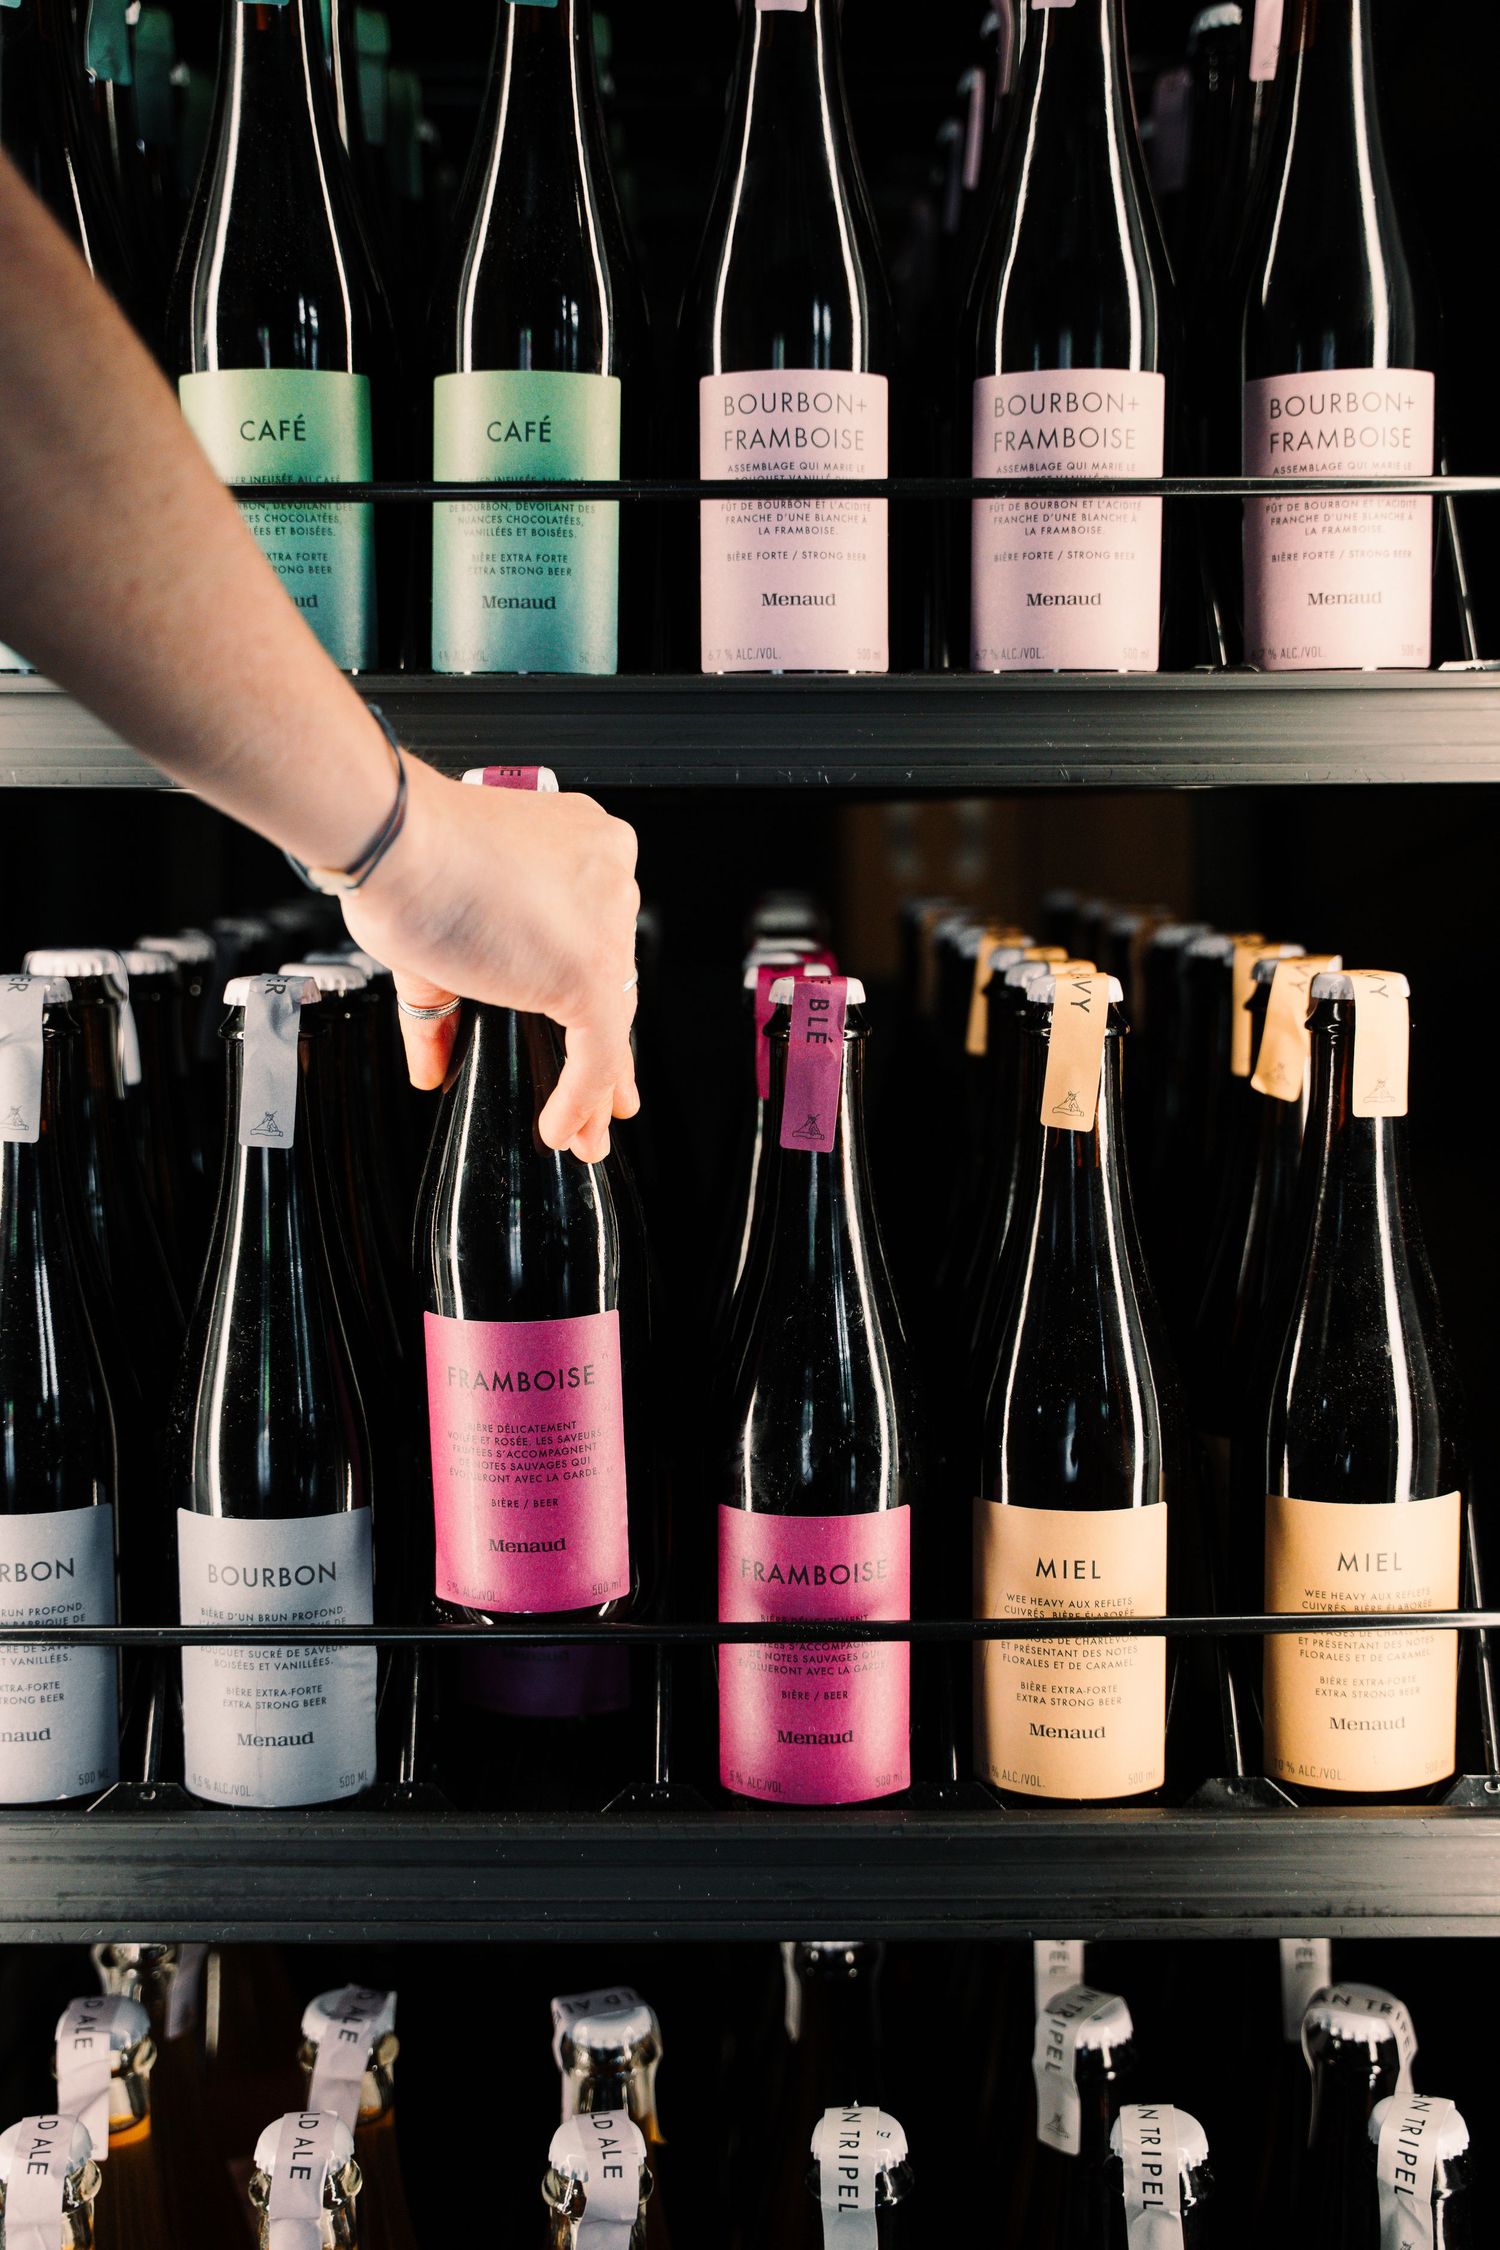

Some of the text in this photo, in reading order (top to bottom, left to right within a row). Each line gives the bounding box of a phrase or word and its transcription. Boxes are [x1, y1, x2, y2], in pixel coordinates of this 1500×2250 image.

[724, 392, 867, 416] BOURBON+
[994, 392, 1140, 418] BOURBON+
[1270, 392, 1414, 419] BOURBON+
[240, 414, 306, 441] CAFÉ
[487, 416, 551, 442] CAFÉ
[724, 428, 864, 450] FRAMBOISE
[994, 427, 1135, 452] FRAMBOISE
[1270, 427, 1411, 453] FRAMBOISE
[728, 462, 852, 473] ASSEMBLAGE QUI MARIE
[997, 462, 1136, 474] ASSEMBLAGE QUI MARIE LE
[1273, 462, 1412, 475] ASSEMBLAGE QUI MARIE LE
[741, 500, 826, 510] DE BOURBON ET
[1008, 500, 1093, 511] DE BOURBON ET
[1287, 500, 1358, 512] DE BOURBON
[264, 513, 342, 524] CHOCOLATÉES,
[458, 514, 584, 527] NUANCES CHOCOLATÉES,
[726, 513, 858, 524] FRANCHE D'UNE BLANCHE
[994, 512, 1127, 524] FRANCHE BLANCHE
[1271, 512, 1405, 526] FRANCHE BLANCHE
[275, 526, 336, 536] ET BOISÉES.
[464, 527, 577, 538] VANILLÉES ET BOISÉES.
[758, 527, 771, 535] LA
[1024, 527, 1036, 535] LA
[1305, 527, 1317, 536] LA
[297, 552, 328, 562] FORTE
[501, 554, 568, 563] EXTRA FORTE
[727, 551, 844, 562] BIÈRE FORTE STRONG
[994, 551, 1110, 562] BIÈRE FORTE STRONG
[1272, 550, 1390, 563] BIÈRE FORTE STRONG
[309, 566, 332, 574] BEER
[500, 566, 572, 576] STRONG BEER
[482, 596, 556, 610] Menaud
[762, 592, 836, 606] Menaud
[1026, 592, 1101, 606] Menaud
[1308, 591, 1382, 606] Menaud
[806, 999, 833, 1044] BLÉ
[448, 1364, 595, 1392] FRAMBOISE
[497, 1420, 577, 1434] DÉLICATEMENT
[536, 1430, 602, 1445] LES SAVEURS
[496, 1442, 597, 1458] S'ACCOMPAGNENT
[510, 1456, 590, 1471] SAUVAGES QUI
[515, 1472, 559, 1483] AVEC LA
[491, 1498, 558, 1508] BIÈRE BEER
[489, 1538, 566, 1553] Menaud
[1036, 1558, 1101, 1579] MIEL
[1337, 1552, 1402, 1572] MIEL
[0, 1558, 74, 1582] RBON
[208, 1562, 336, 1588] BOURBON
[741, 1558, 887, 1586] FRAMBOISE
[592, 1582, 609, 1597] 500
[1304, 1589, 1391, 1600] WEE HEAVY AUX
[1006, 1592, 1132, 1608] WEE HEAVY AUX REFLETS
[201, 1608, 287, 1622] BIÈRE D'UN BRUN
[1298, 1635, 1434, 1650] ET PRÉSENTANT DES NOTES
[248, 1648, 300, 1658] SUCRÉ DE
[1002, 1642, 1138, 1658] ET PRÉSENTANT DES NOTES
[1300, 1649, 1384, 1662] FLORALES ET DE
[11, 1655, 72, 1665] VANILLÉES.
[258, 1658, 334, 1671] ET VANILLÉES.
[765, 1652, 858, 1664] NOTES SAUVAGES
[1003, 1654, 1082, 1670] FLORALES ET DE
[806, 1665, 850, 1676] AVEC LA
[1320, 1676, 1348, 1685] BIÈRE
[256, 1684, 322, 1697] EXTRA-FORTE
[782, 1690, 848, 1700] BIÈRE BEER
[1020, 1682, 1118, 1694] BIÈRE EXTRA-FORTE
[1316, 1688, 1395, 1698] EXTRA STRONG
[40, 1694, 64, 1703] BEER
[256, 1697, 327, 1710] STRONG BEER
[1016, 1694, 1122, 1707] EXTRA STRONG BEER
[1330, 1716, 1405, 1730] Menaud
[776, 1729, 853, 1745] Menaud
[1029, 1722, 1106, 1739] Menaud
[237, 1732, 314, 1747] Menaud
[78, 1773, 96, 1786] 500
[339, 1774, 355, 1788] 500
[1002, 1769, 1045, 1788] ALC./VOL.
[74, 2015, 97, 2049] ALE
[1044, 2001, 1082, 2072] TRIPEL
[290, 2113, 320, 2180] LD ALE
[590, 2111, 622, 2178] LD ALE
[27, 2139, 53, 2175] ALE
[1394, 2119, 1426, 2196] TRIPEL
[838, 2131, 860, 2212] TRIPEL
[1140, 2128, 1163, 2210] TRIPEL
